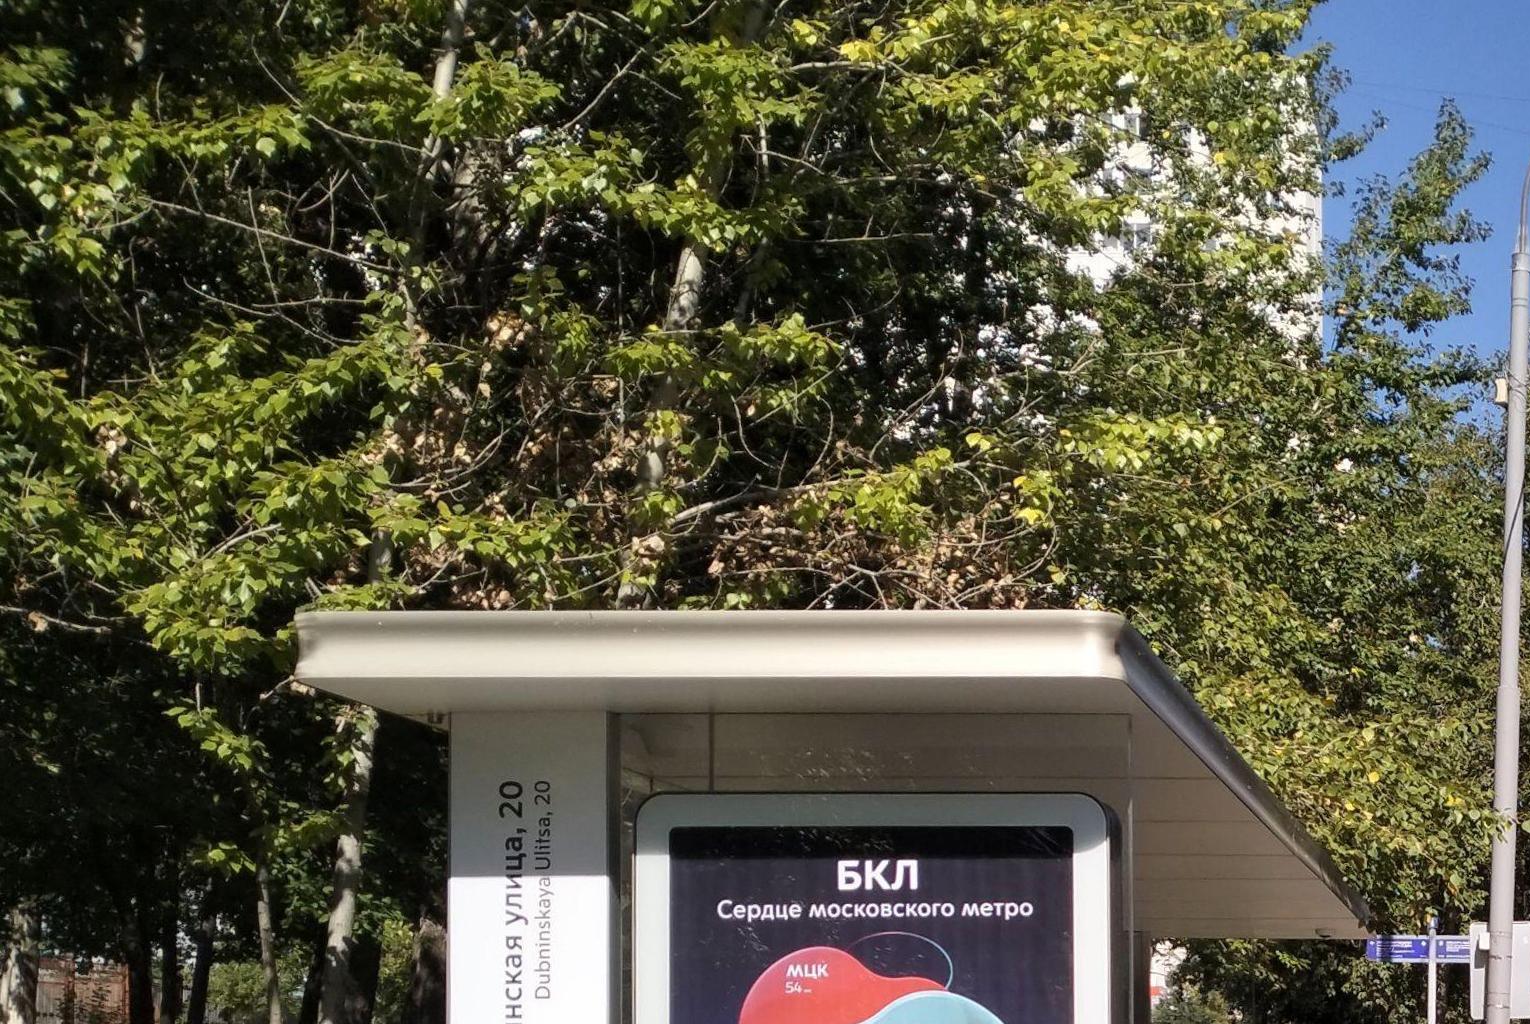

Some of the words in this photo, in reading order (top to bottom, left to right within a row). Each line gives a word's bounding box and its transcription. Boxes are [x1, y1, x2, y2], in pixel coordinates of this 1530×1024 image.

[499, 780, 523, 819] 20
[534, 780, 551, 805] 20
[534, 812, 553, 871] Ulitsa,
[505, 827, 528, 926] улица,
[837, 859, 919, 891] БКЛ
[716, 899, 802, 922] Сердце
[808, 902, 955, 918] московского
[961, 901, 1034, 921] метро
[534, 876, 554, 1000] Dubninskaya
[784, 981, 802, 994] 54
[786, 963, 829, 980] МЦК
